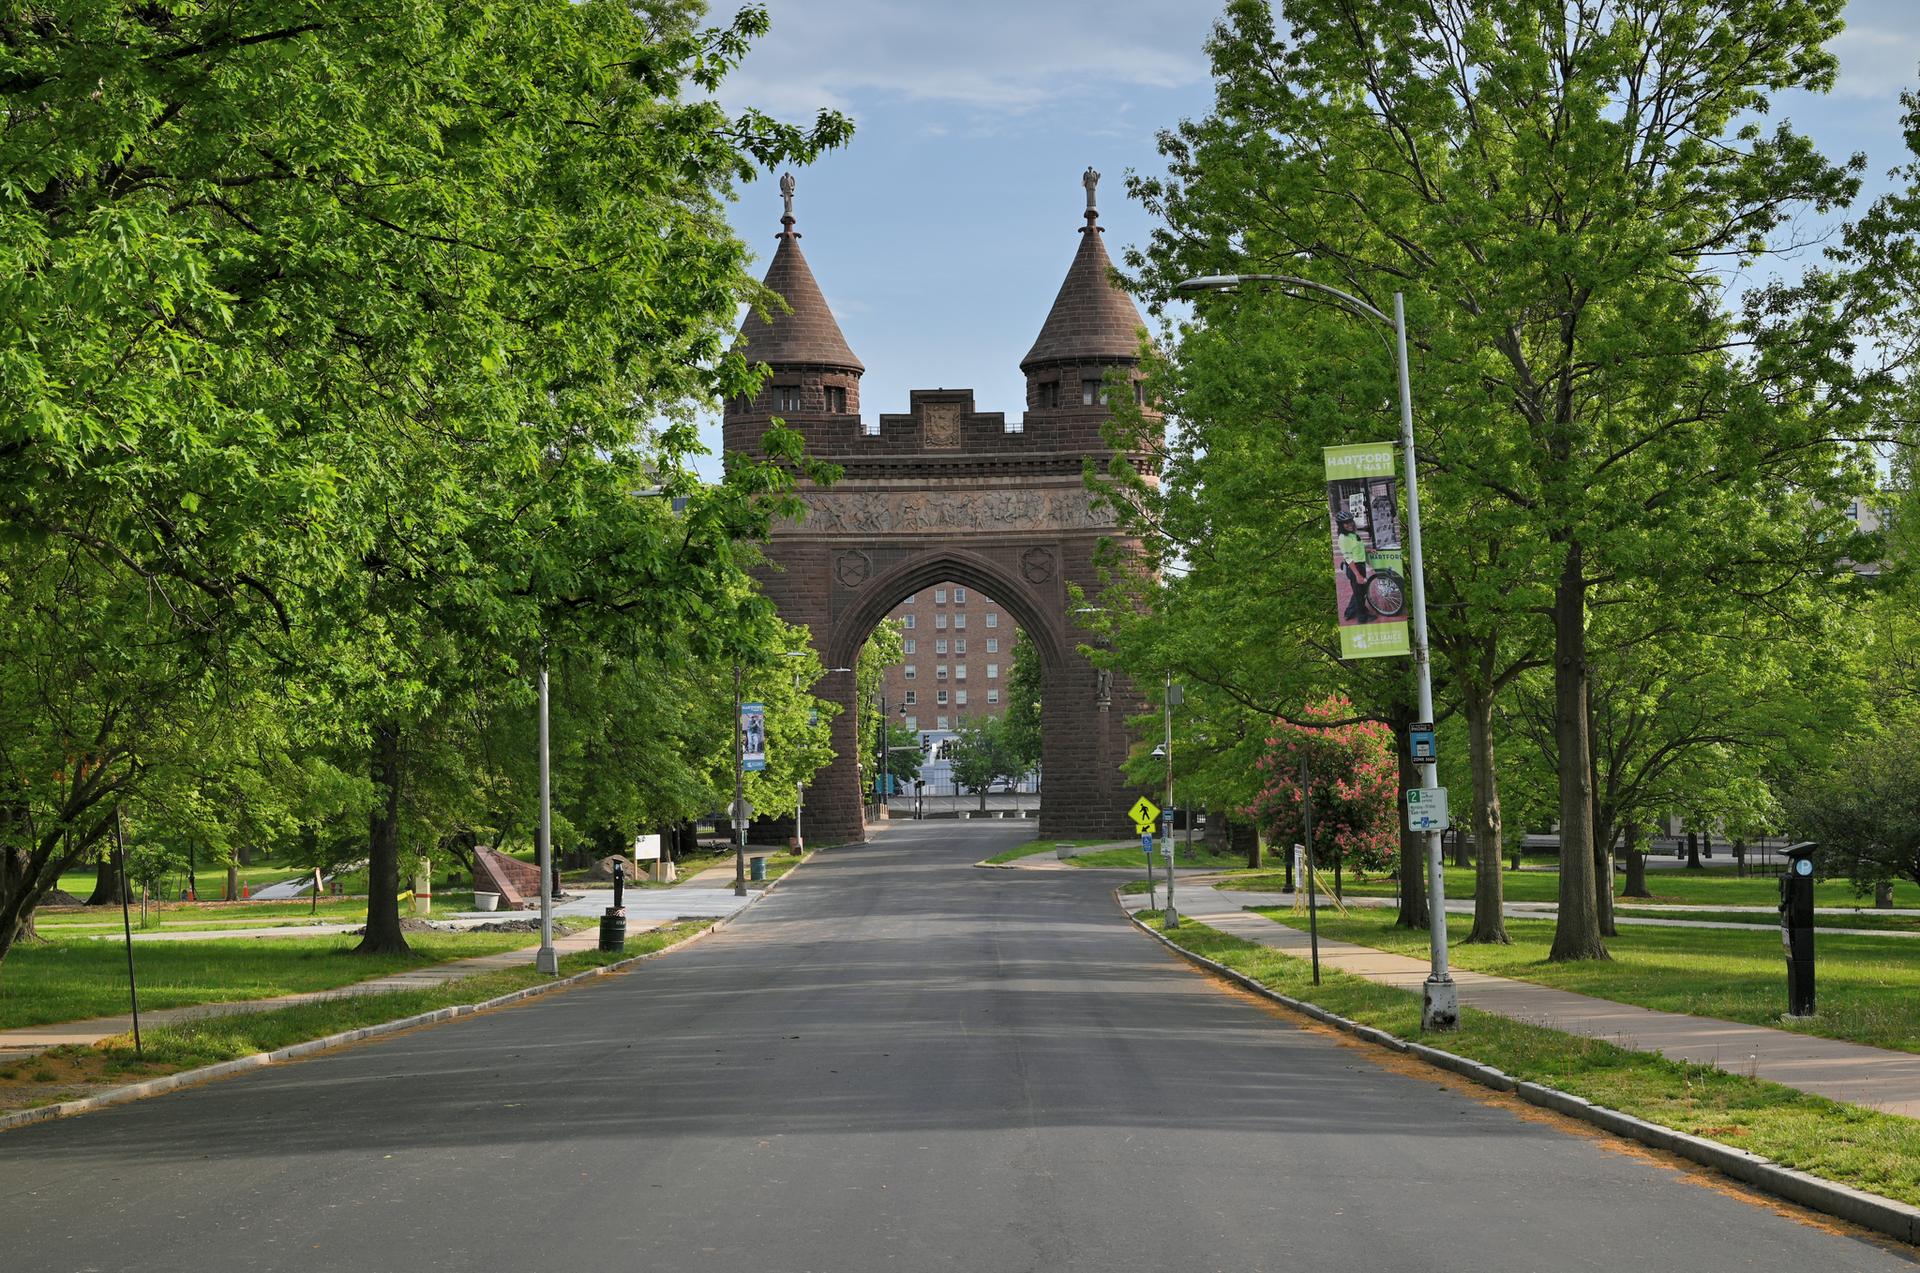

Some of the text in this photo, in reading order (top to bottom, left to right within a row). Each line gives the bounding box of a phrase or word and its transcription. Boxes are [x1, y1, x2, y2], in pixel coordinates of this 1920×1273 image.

[1327, 452, 1391, 466] HARTFORD
[1363, 462, 1391, 471] HAS IT
[1411, 791, 1417, 802] 2
